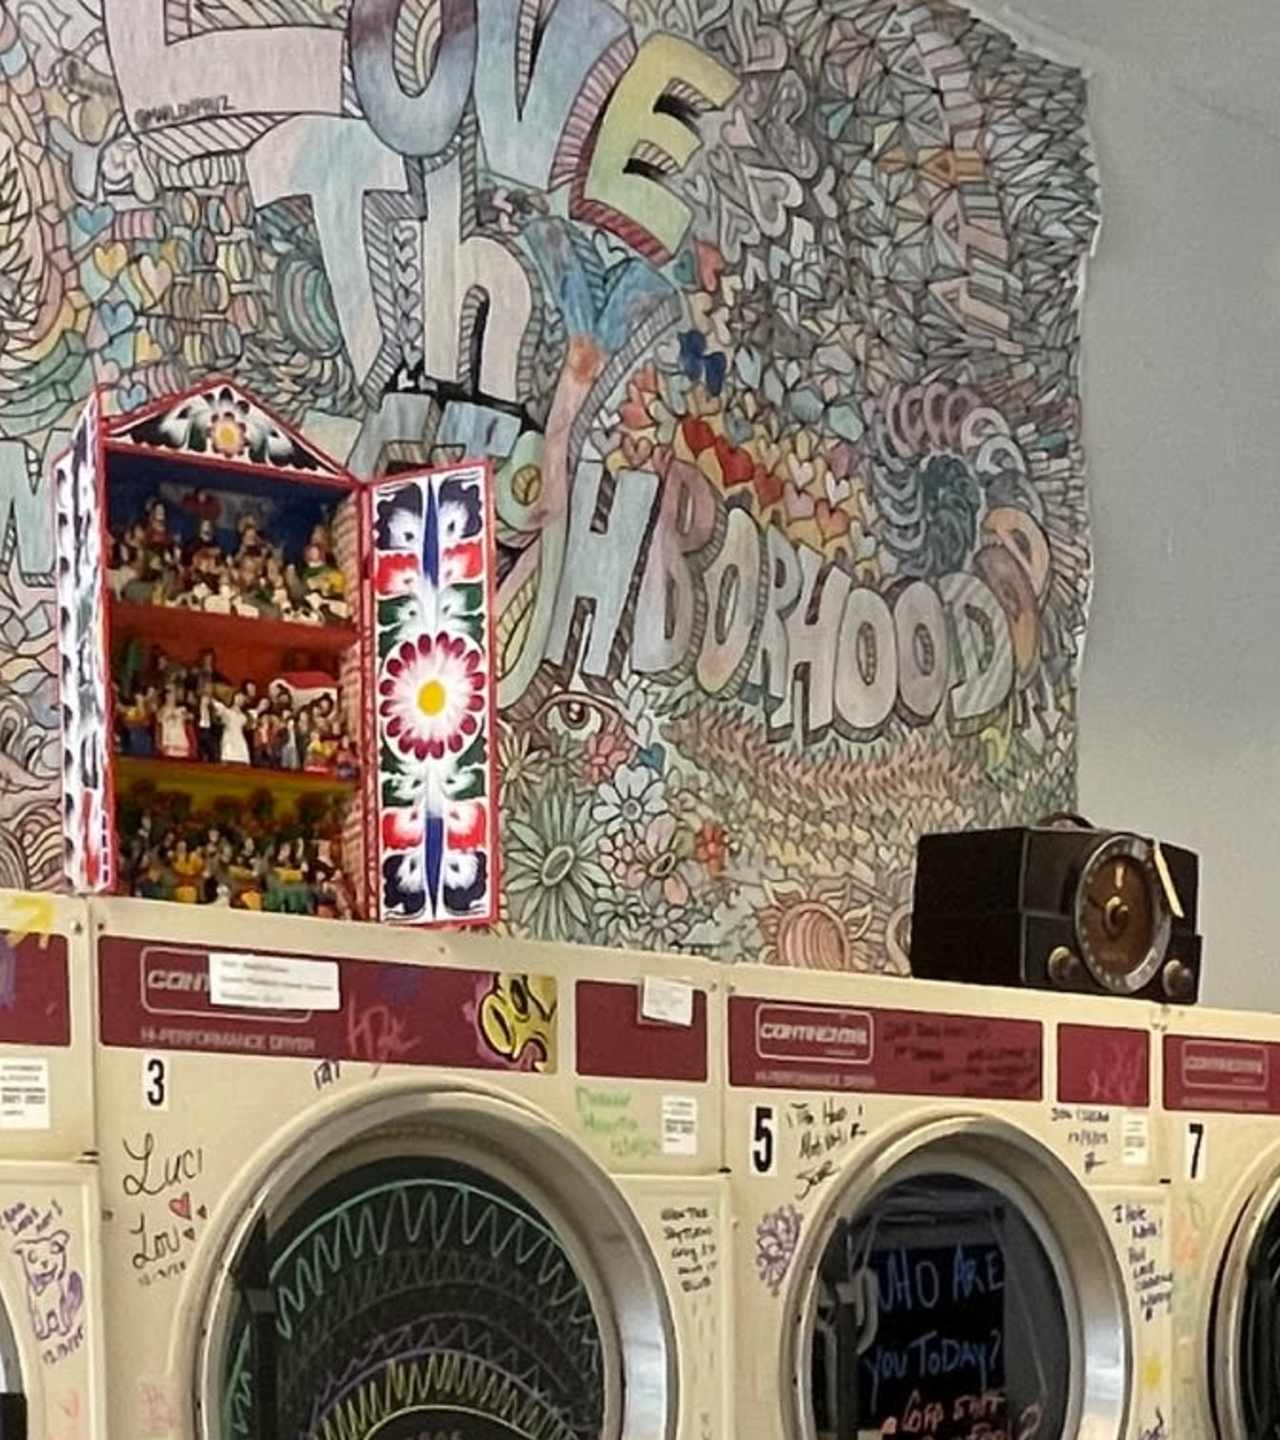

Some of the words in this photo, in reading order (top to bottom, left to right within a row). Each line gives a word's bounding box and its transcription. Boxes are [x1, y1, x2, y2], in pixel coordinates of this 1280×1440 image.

[146, 1058, 166, 1106] 3
[753, 1106, 773, 1172] 5
[1188, 1123, 1205, 1179] 7
